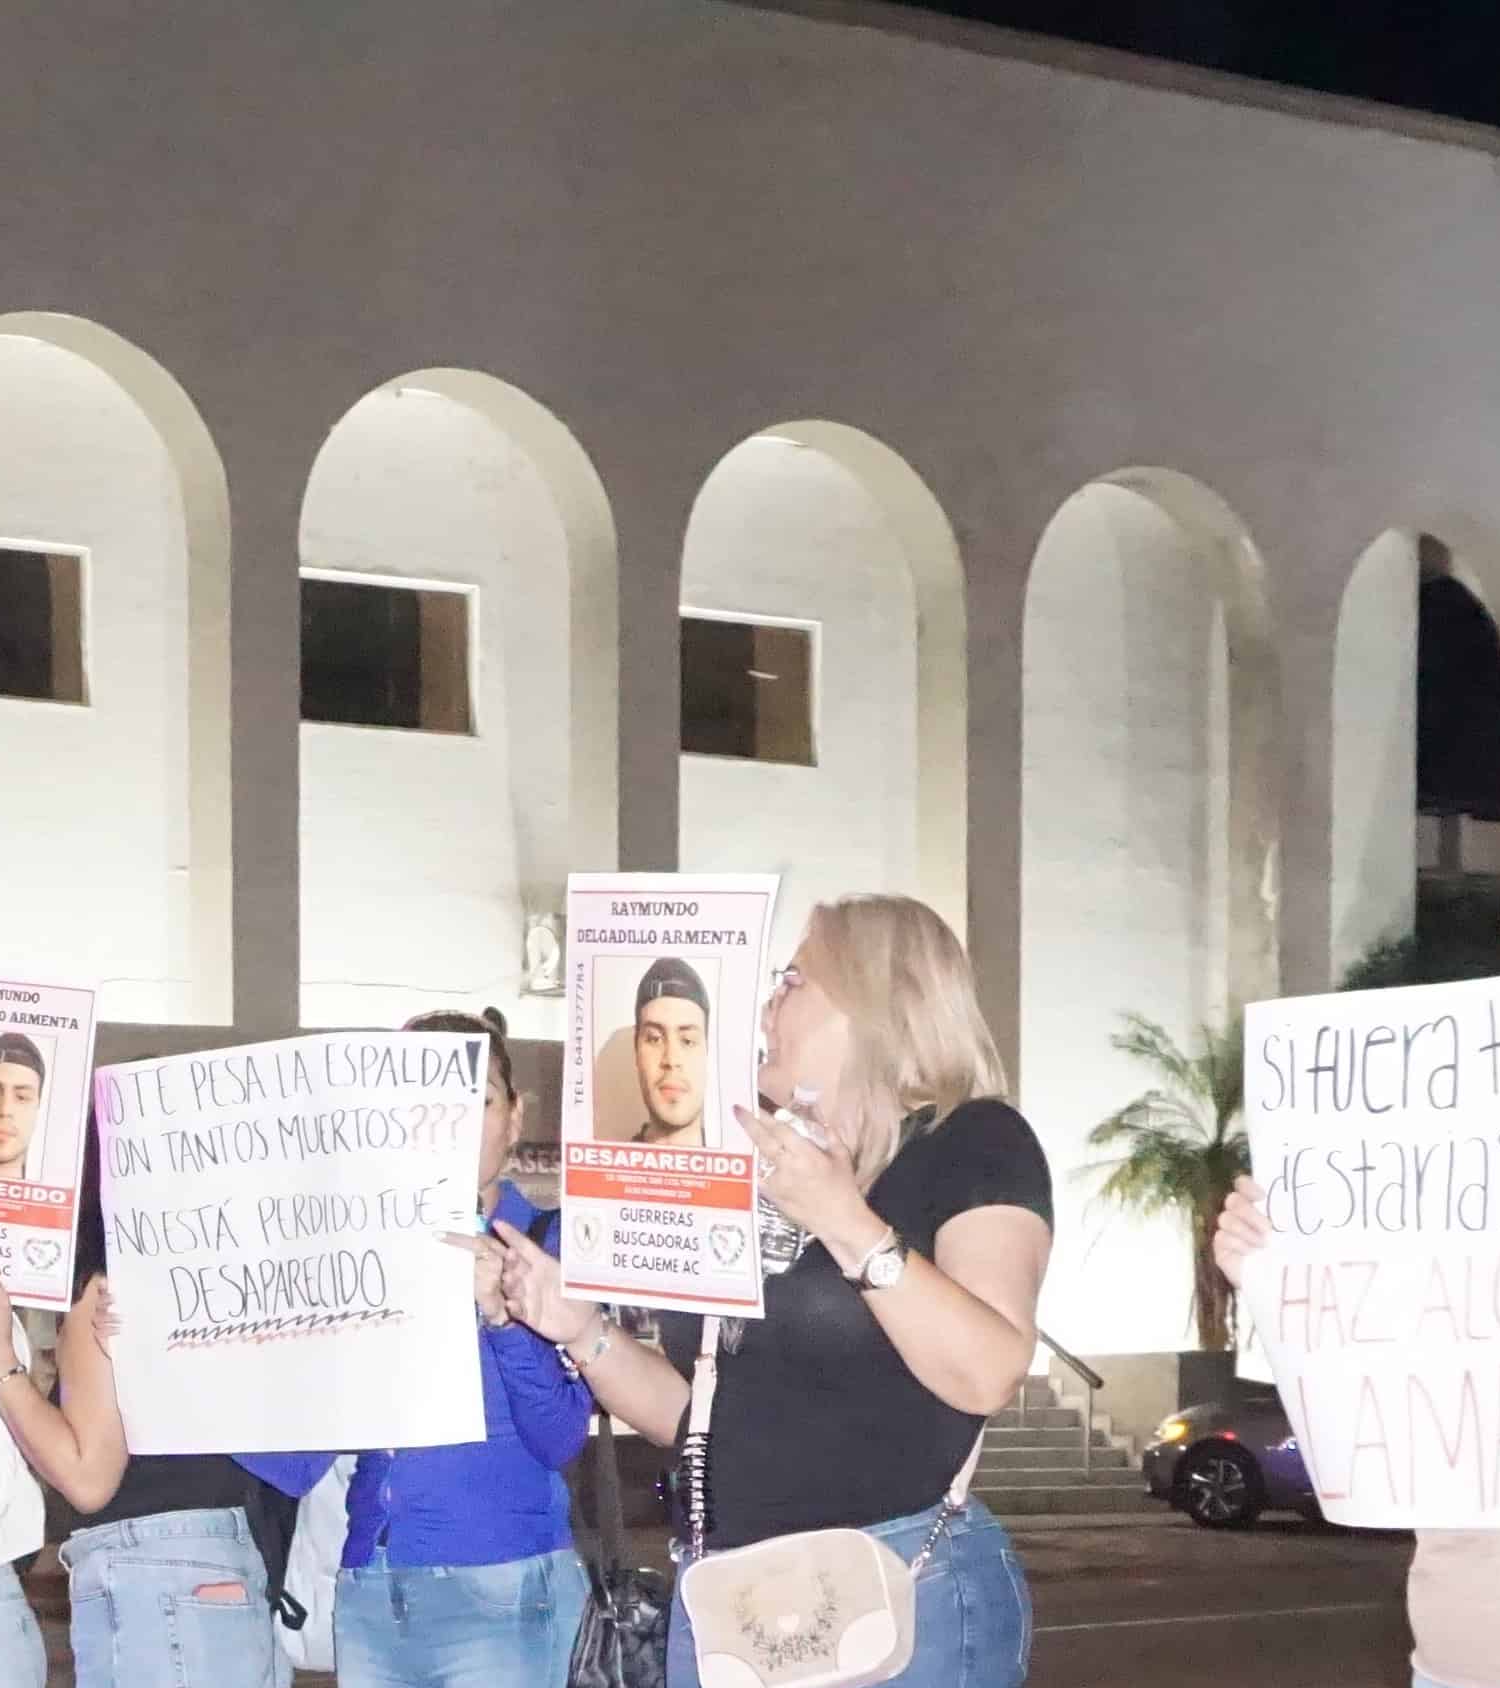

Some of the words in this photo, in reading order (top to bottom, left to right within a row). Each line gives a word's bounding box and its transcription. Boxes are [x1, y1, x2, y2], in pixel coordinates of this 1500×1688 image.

[611, 901, 699, 917] RAYMUNDO
[577, 927, 658, 945] DELGADILLO
[662, 929, 748, 946] ARMENTA
[10, 1011, 79, 1031] ARMENTA
[1306, 1015, 1459, 1115] fuera
[128, 1065, 177, 1118] TE
[190, 1054, 267, 1112] PESA
[276, 1049, 313, 1097] LA
[107, 1134, 152, 1179] CON
[162, 1120, 269, 1172] TANTOS
[569, 1146, 748, 1177] DESAPARECIDO
[258, 1195, 368, 1245] PERDIDO
[619, 1207, 695, 1228] GUERRERAS
[613, 1229, 701, 1252] BUSCADORAS
[612, 1253, 628, 1269] DE
[632, 1254, 678, 1273] CAJEME
[683, 1260, 701, 1275] AC
[169, 1249, 387, 1323] DESAPARECIDO
[1278, 1260, 1396, 1352] HAZ
